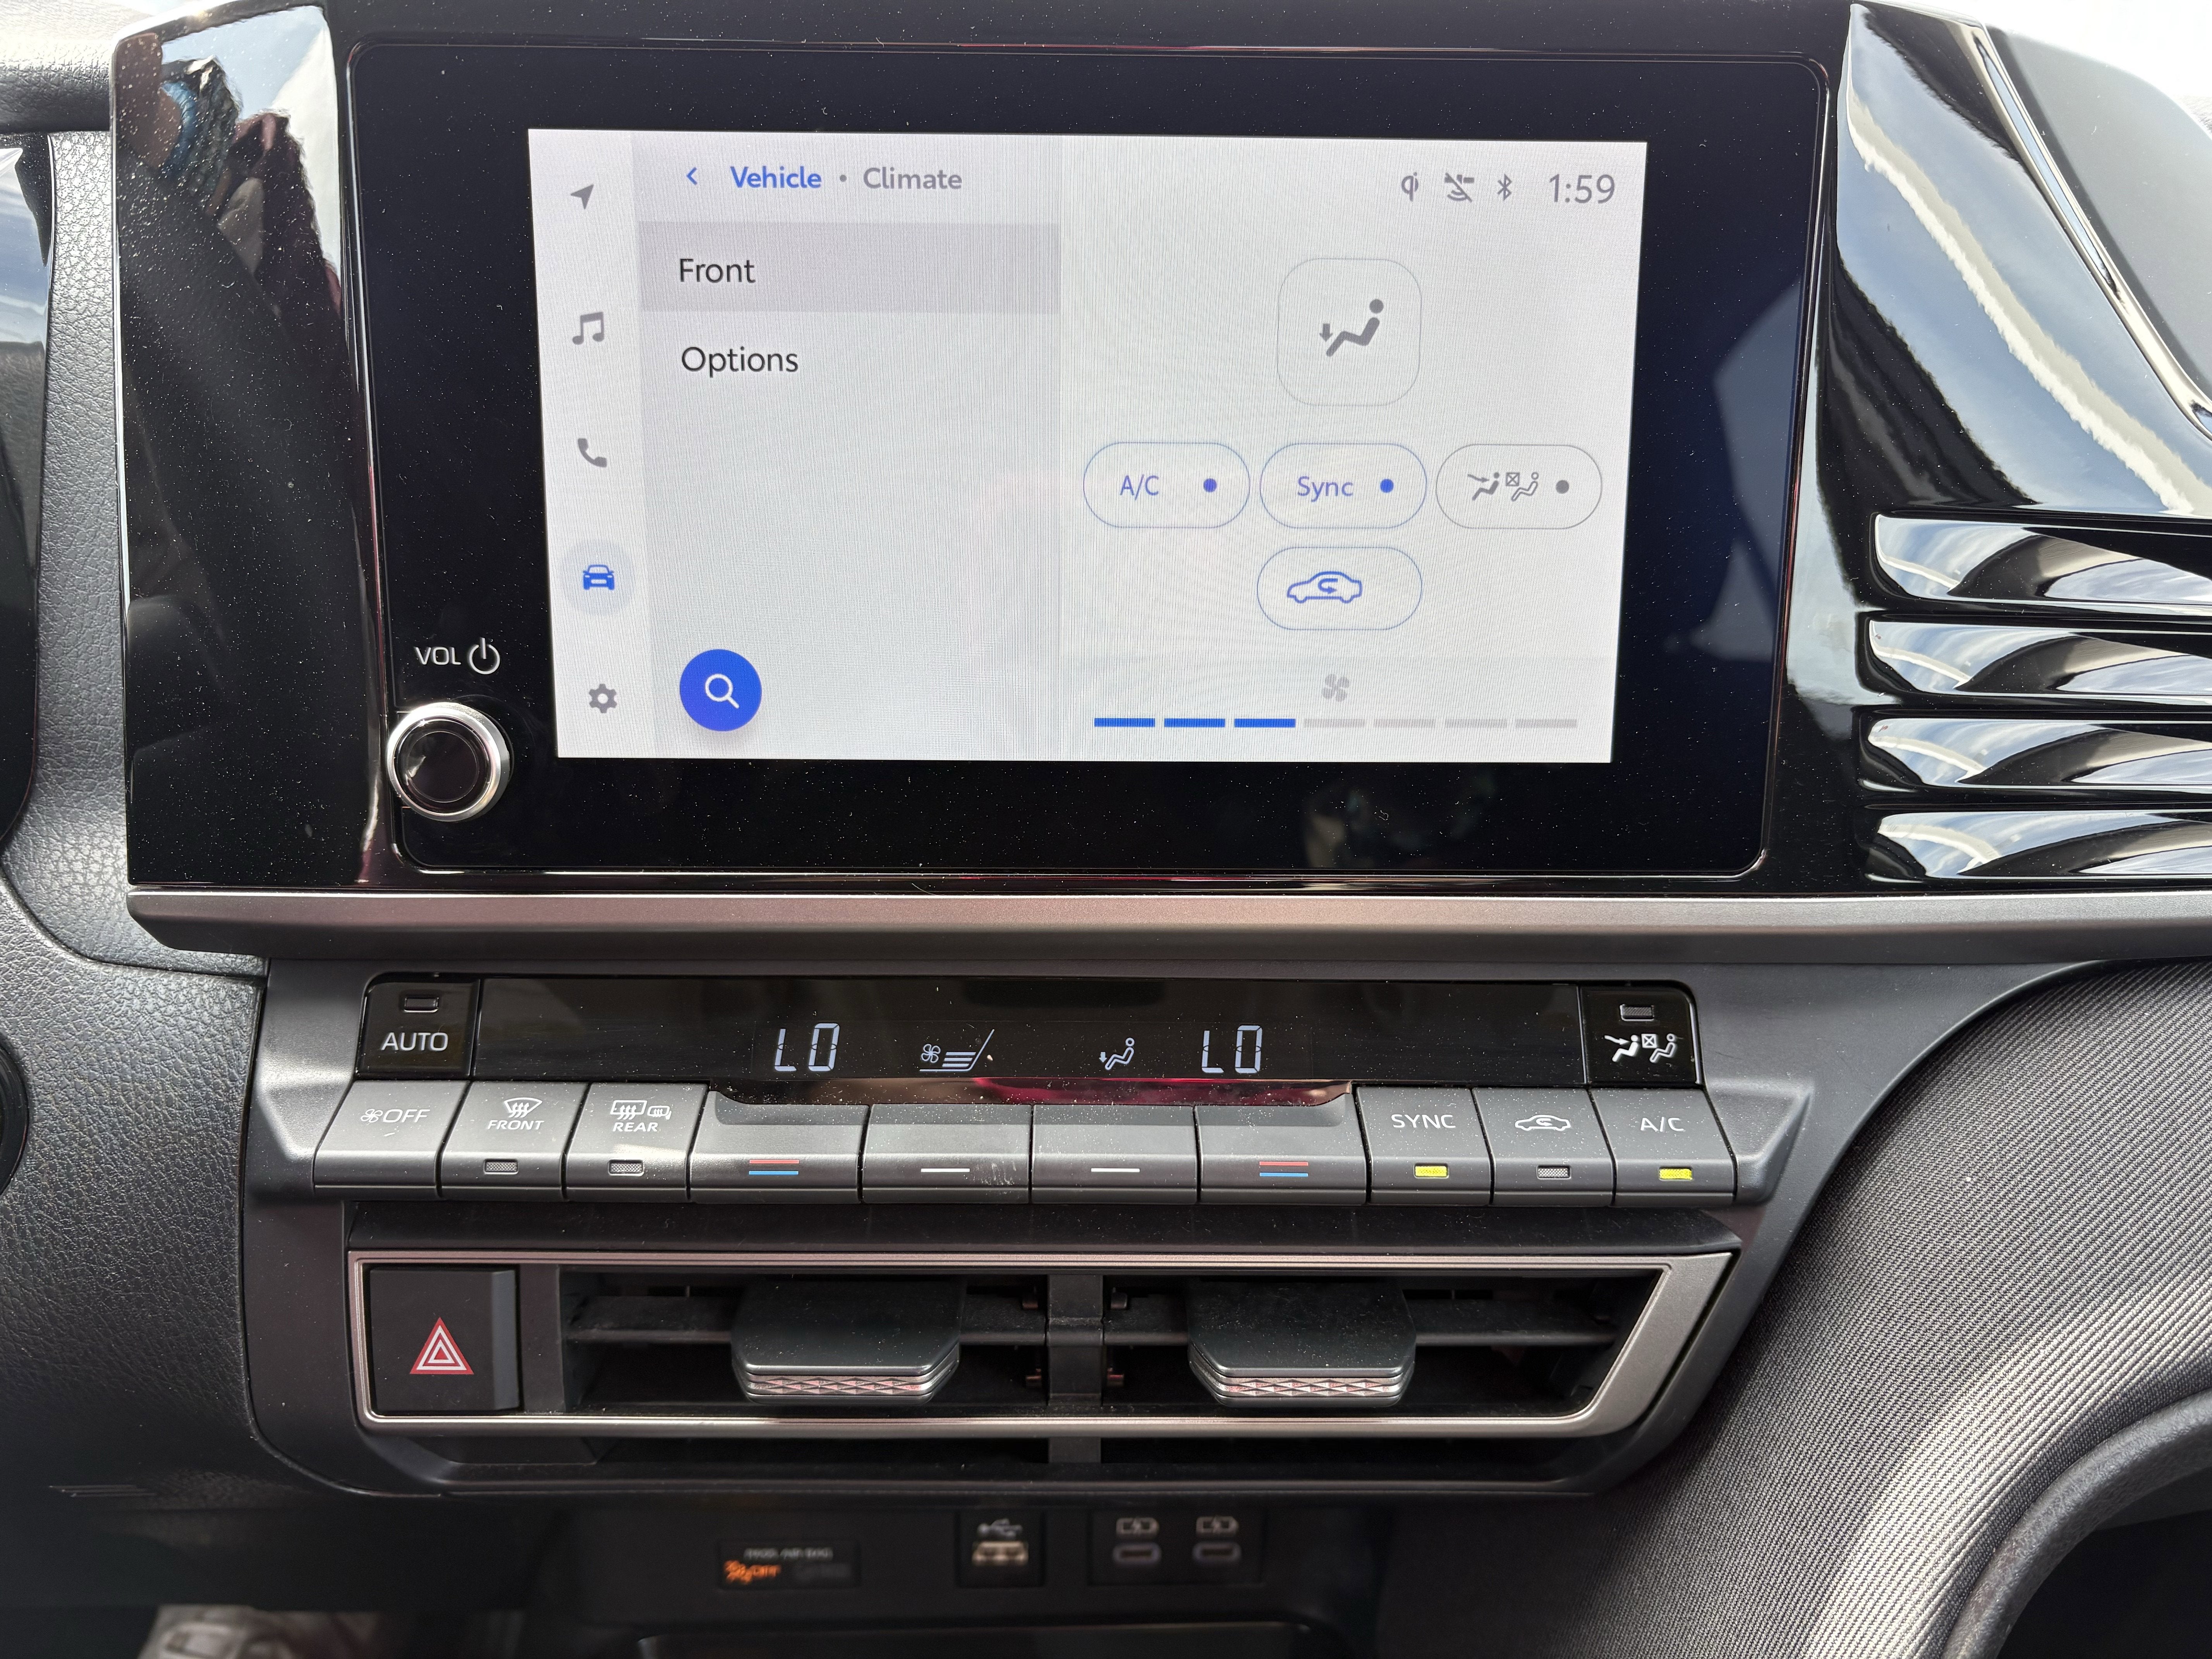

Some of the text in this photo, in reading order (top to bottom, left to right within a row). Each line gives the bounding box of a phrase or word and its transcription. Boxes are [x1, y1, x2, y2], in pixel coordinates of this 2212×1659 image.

[730, 165, 963, 190] Vehicle Climate
[1549, 173, 1616, 204] 1:59
[679, 258, 756, 283] Front
[681, 346, 799, 377] Options
[1119, 474, 1159, 500] A/C
[1297, 476, 1353, 502] Sync
[414, 646, 461, 666] VOL
[381, 1032, 448, 1052] AUTO
[775, 1023, 840, 1072] LO
[1201, 1025, 1262, 1074] LO
[382, 1108, 430, 1123] OFF
[487, 1120, 544, 1130] FRONT
[612, 1122, 658, 1132] REAR
[1391, 1113, 1456, 1129] SYNC
[1640, 1117, 1685, 1132] A/C
